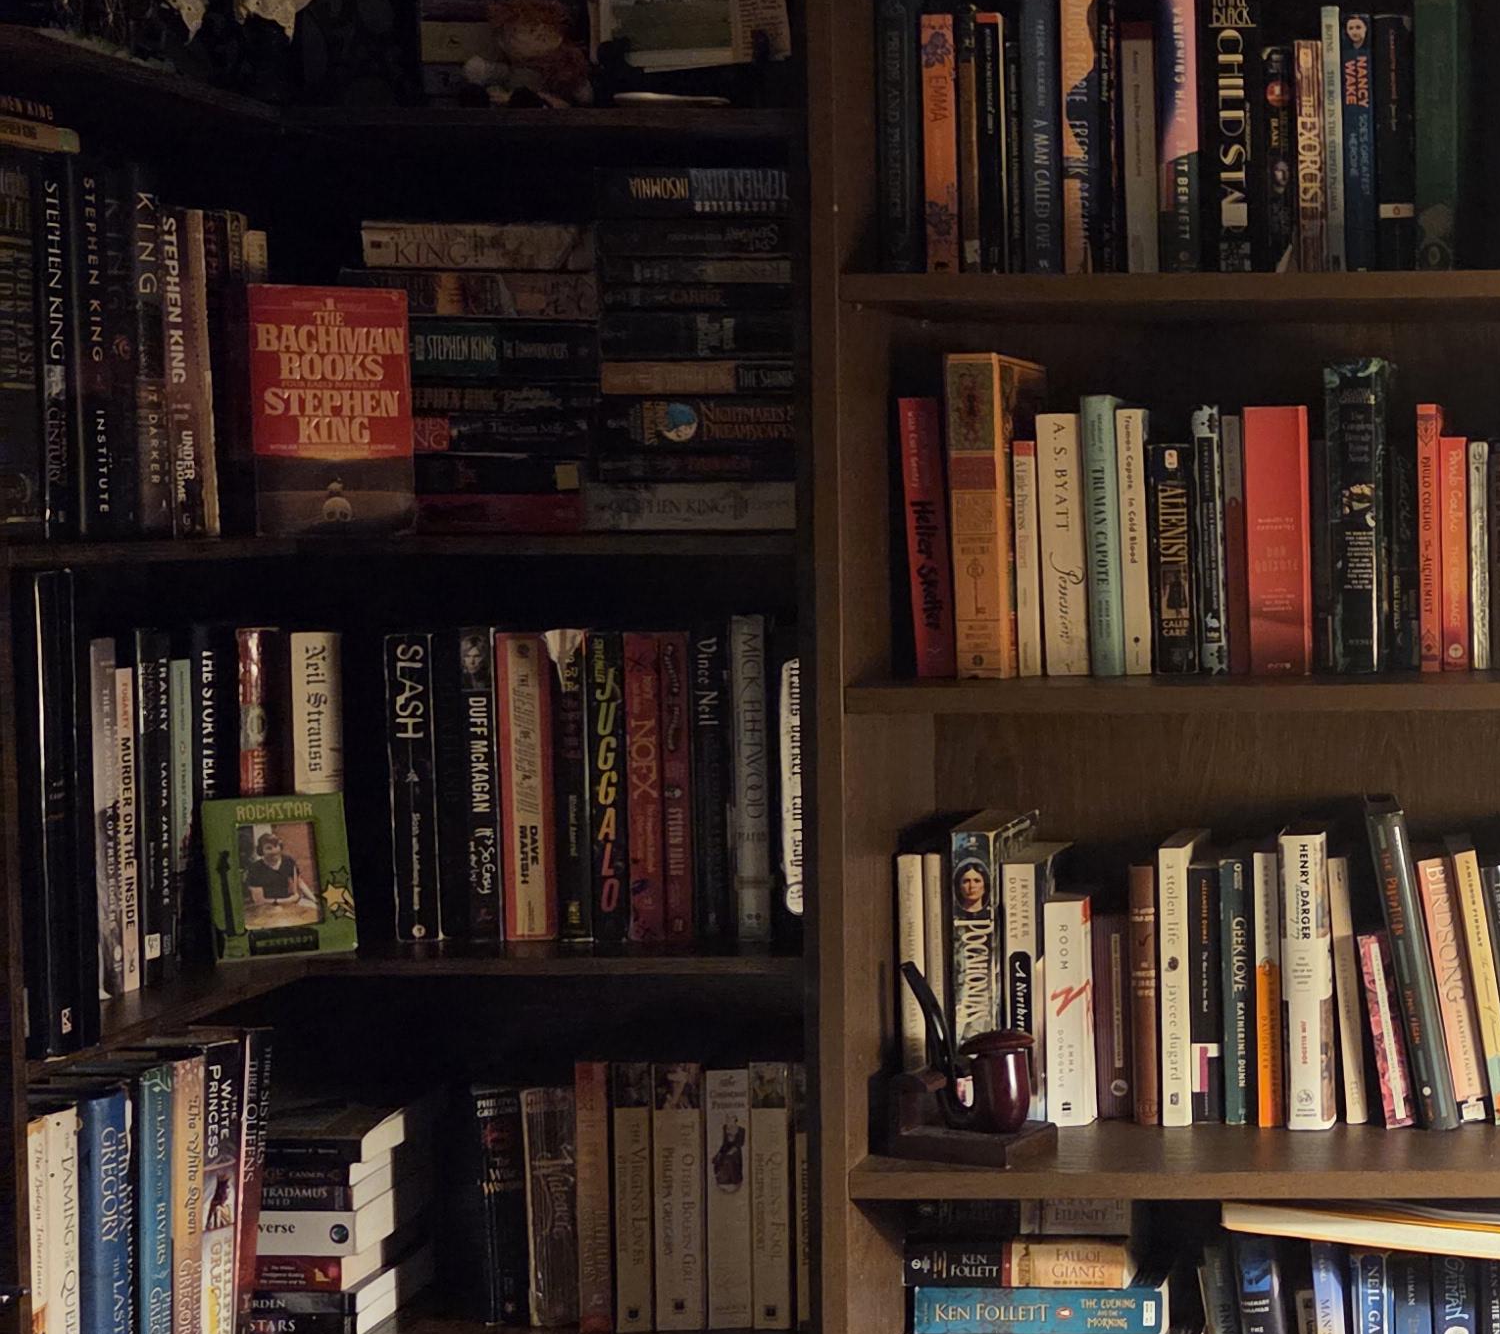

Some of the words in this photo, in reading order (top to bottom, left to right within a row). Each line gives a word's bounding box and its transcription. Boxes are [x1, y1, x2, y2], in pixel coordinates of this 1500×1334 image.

[1212, 8, 1251, 27] BLACK
[1216, 30, 1247, 137] CHILD
[1220, 144, 1248, 233] STAR
[83, 177, 99, 285] STEPHEN
[88, 299, 103, 362] KING
[256, 324, 402, 353] BACHMAN
[278, 354, 384, 381] BOOKS
[263, 389, 399, 417] STEPHEN
[298, 418, 370, 444] KING
[95, 409, 109, 513] INSTITUTE
[912, 501, 935, 563] Helter
[916, 565, 941, 630] Skelter
[396, 644, 424, 739] SLASH
[468, 697, 487, 735] DUFF
[469, 738, 490, 813] McKAGAN
[596, 669, 621, 912] JUGGALO
[236, 803, 312, 821] ROCKSTAR
[1299, 844, 1308, 886] HENRY
[1234, 917, 1247, 956] GEEK
[1299, 890, 1309, 940] DARGER
[1424, 866, 1466, 1004] BIRDSONG
[1058, 923, 1070, 971] ROOM
[1234, 958, 1246, 995] LOVE
[936, 1305, 970, 1320] KEN
[976, 1305, 1049, 1321] FOLLETT
